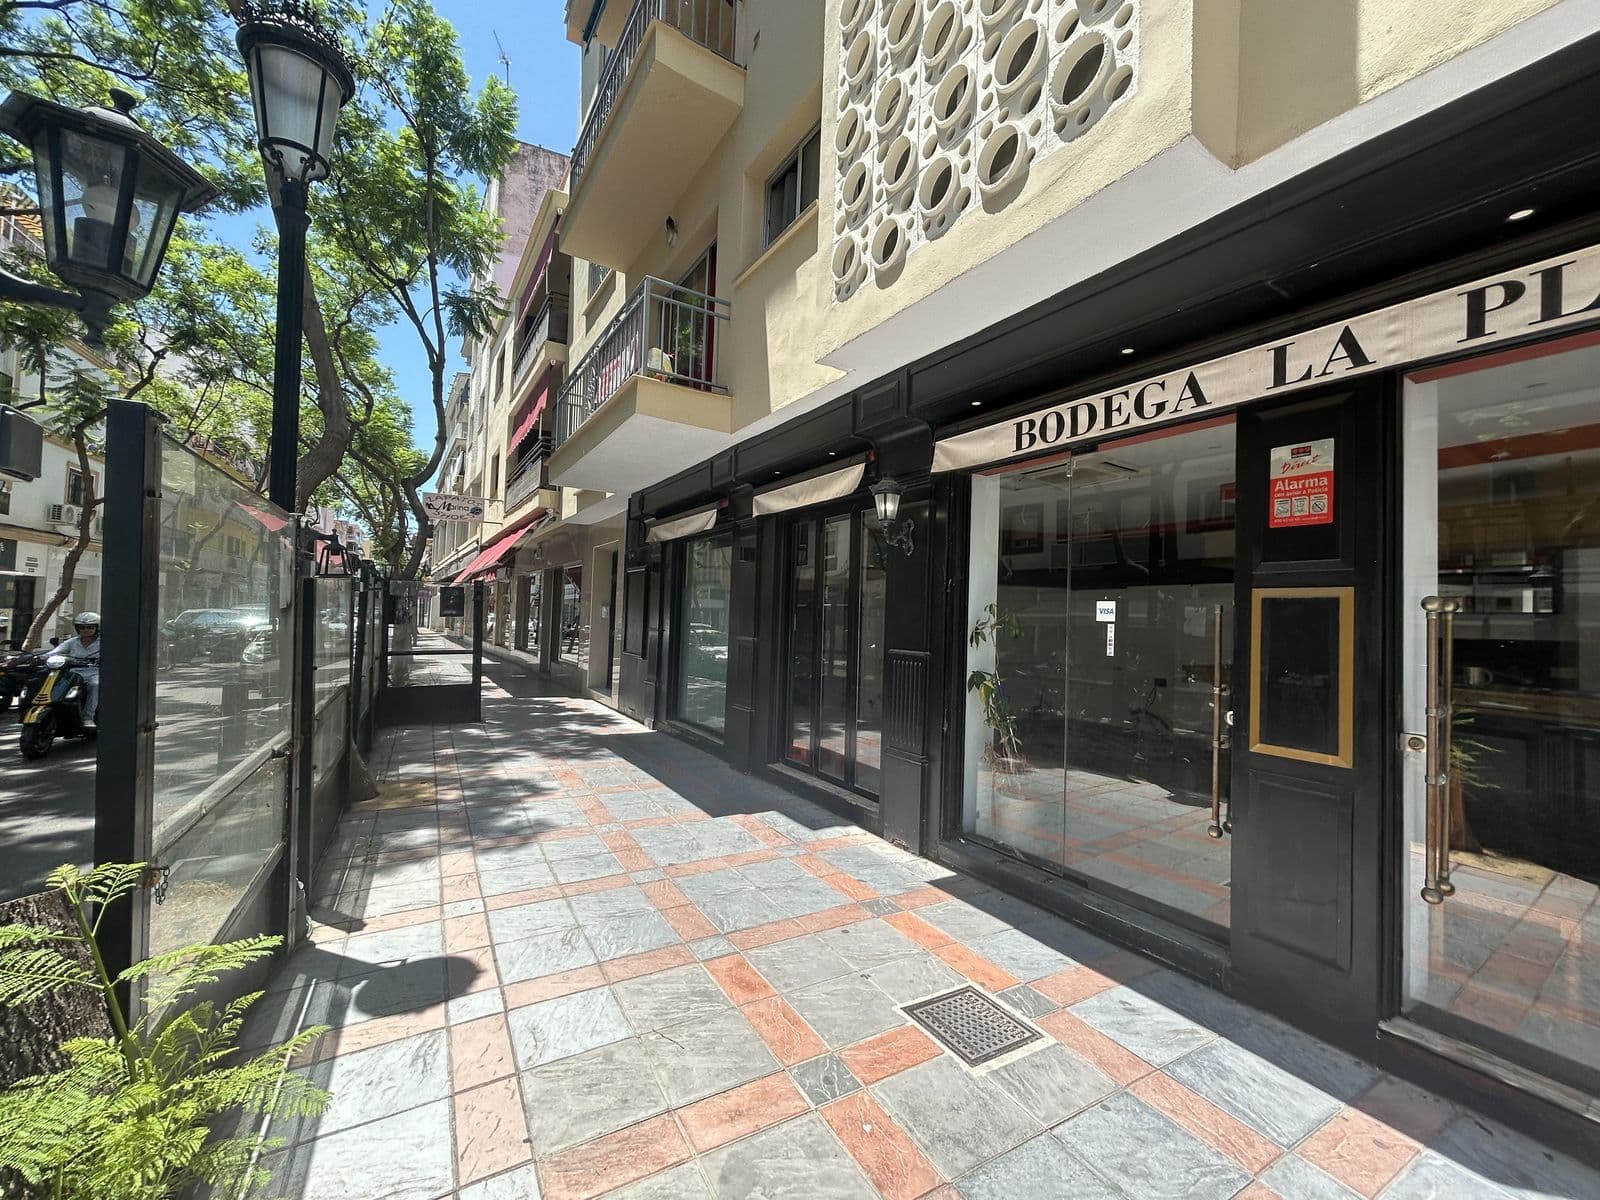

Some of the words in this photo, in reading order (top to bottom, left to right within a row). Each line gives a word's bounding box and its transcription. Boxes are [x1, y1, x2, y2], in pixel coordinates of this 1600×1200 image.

[1012, 371, 1212, 452] BODEGA
[1266, 325, 1377, 390] LA
[1275, 476, 1328, 491] Alarma
[433, 501, 469, 511] Marina
